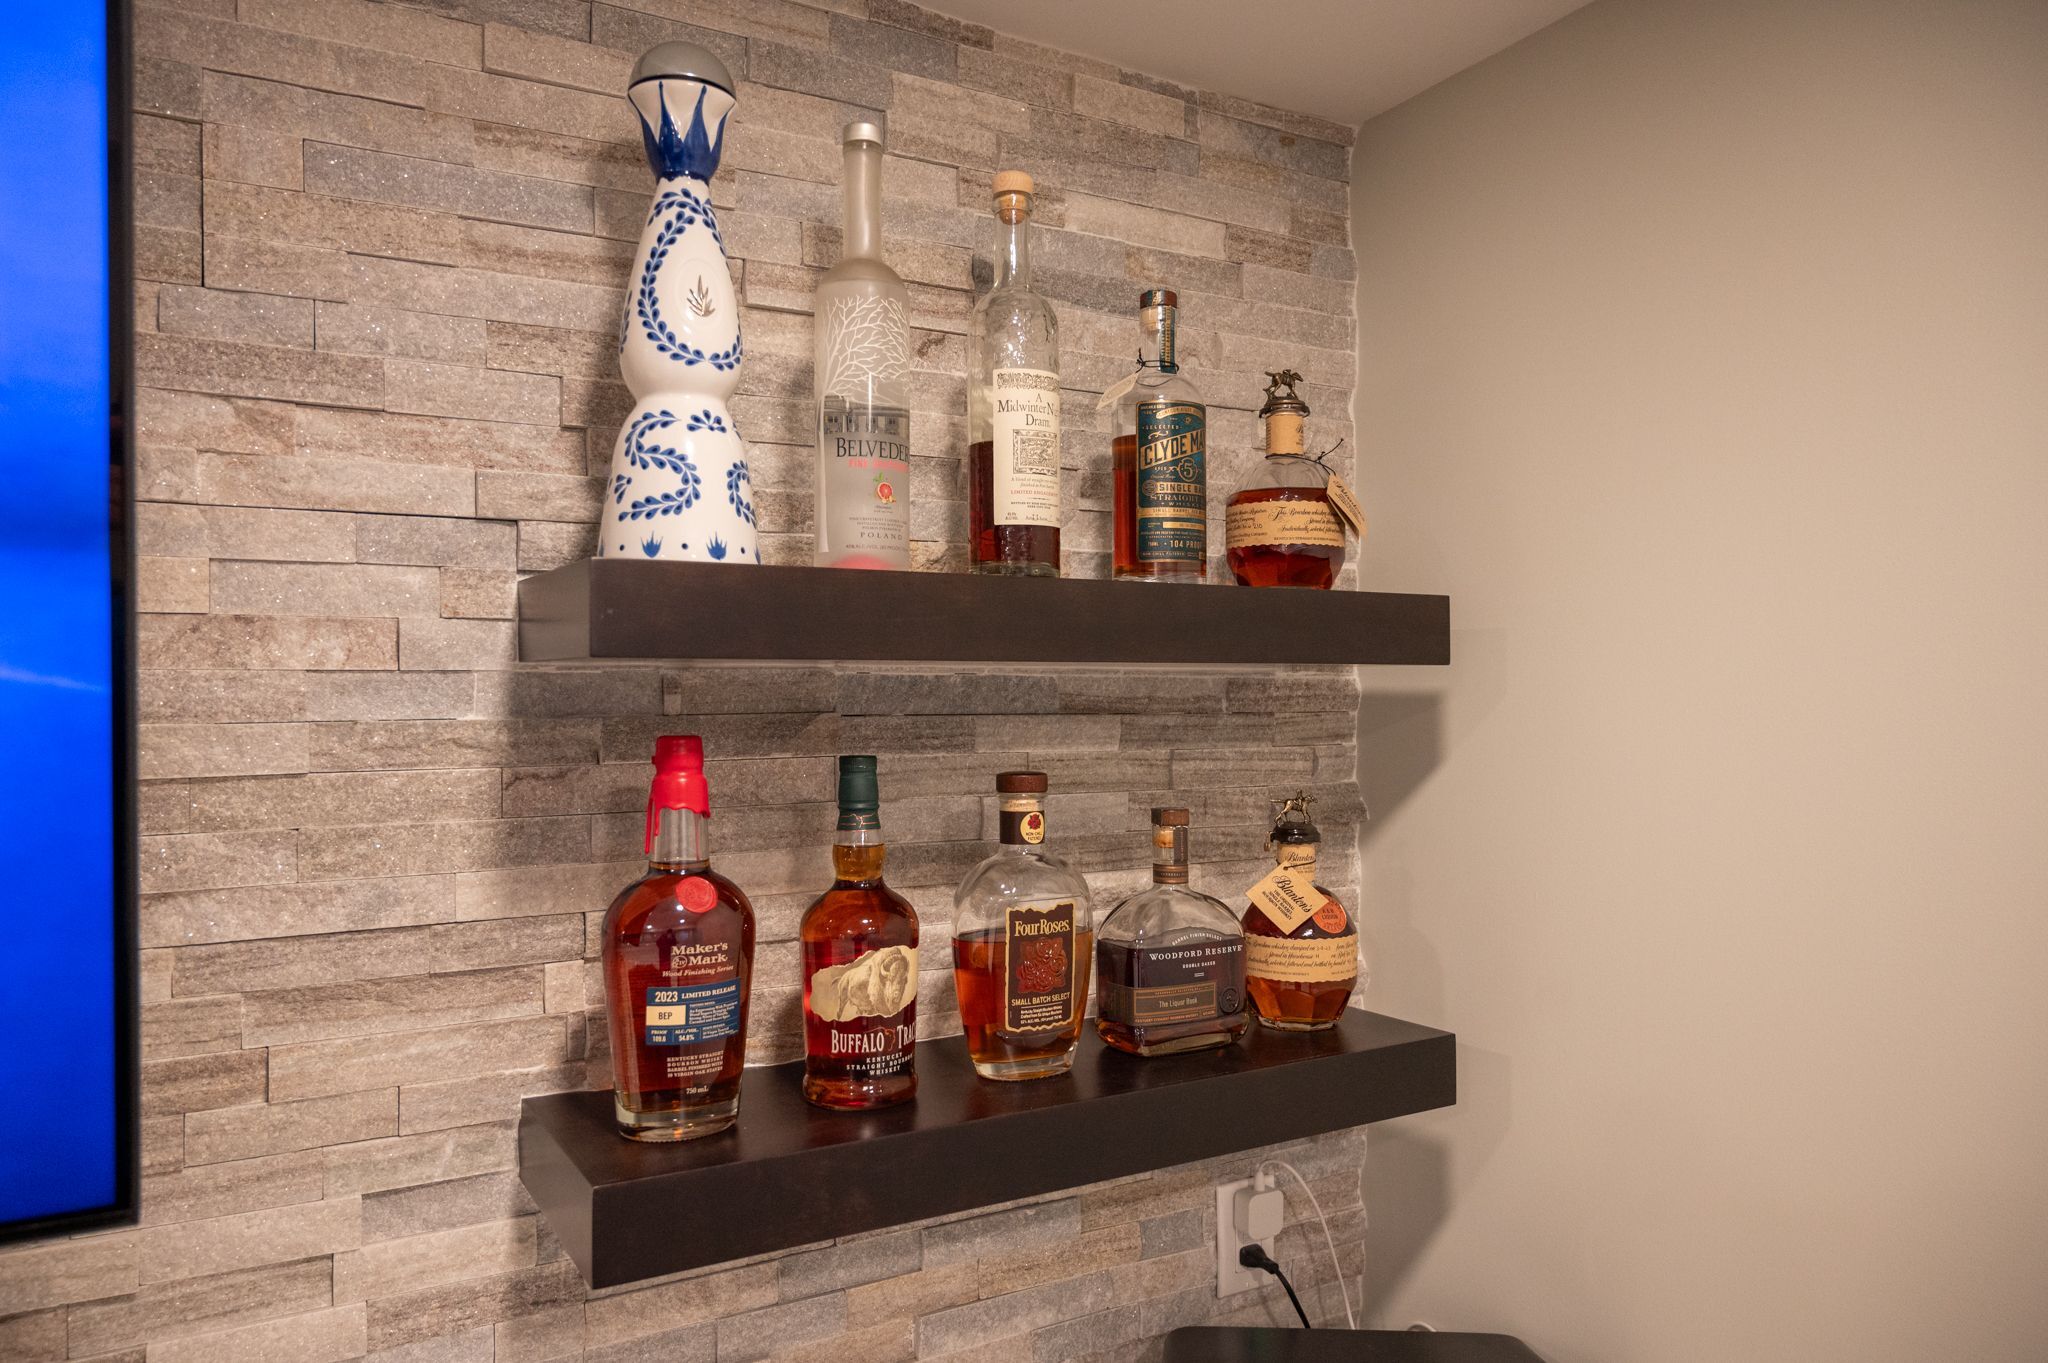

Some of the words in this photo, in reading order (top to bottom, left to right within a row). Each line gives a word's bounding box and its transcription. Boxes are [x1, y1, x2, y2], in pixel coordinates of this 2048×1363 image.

[997, 399, 1047, 414] Midwinter
[1144, 435, 1187, 466] CLYDE
[1183, 462, 1193, 478] 5
[1159, 483, 1191, 493] SINGLE
[861, 532, 902, 540] POLAND
[1170, 540, 1184, 548] 104
[1271, 874, 1312, 912] Blanton's
[1014, 920, 1040, 937] Four
[1039, 918, 1070, 935] Roses
[1172, 935, 1189, 946] BARREL
[671, 942, 728, 955] Maker's
[1149, 949, 1202, 960] WOODFORD
[1206, 945, 1242, 956] RESERVE
[688, 953, 729, 966] Mark
[684, 967, 716, 976] Finishing
[655, 990, 678, 1002] 2023
[682, 990, 711, 999] LIMITED
[712, 985, 736, 996] RELEASE
[1011, 998, 1031, 1007] SMALL
[1032, 995, 1051, 1004] BATCH
[1051, 991, 1070, 1001] SELECT
[1159, 1000, 1169, 1008] The
[1170, 999, 1185, 1007] Liquor
[658, 1012, 672, 1020] BEP
[831, 1029, 885, 1053] BUFFALO
[866, 1051, 903, 1063] KENTUCKY
[846, 1061, 886, 1070] STRAIGHT
[869, 1065, 901, 1076] WHISKEY
